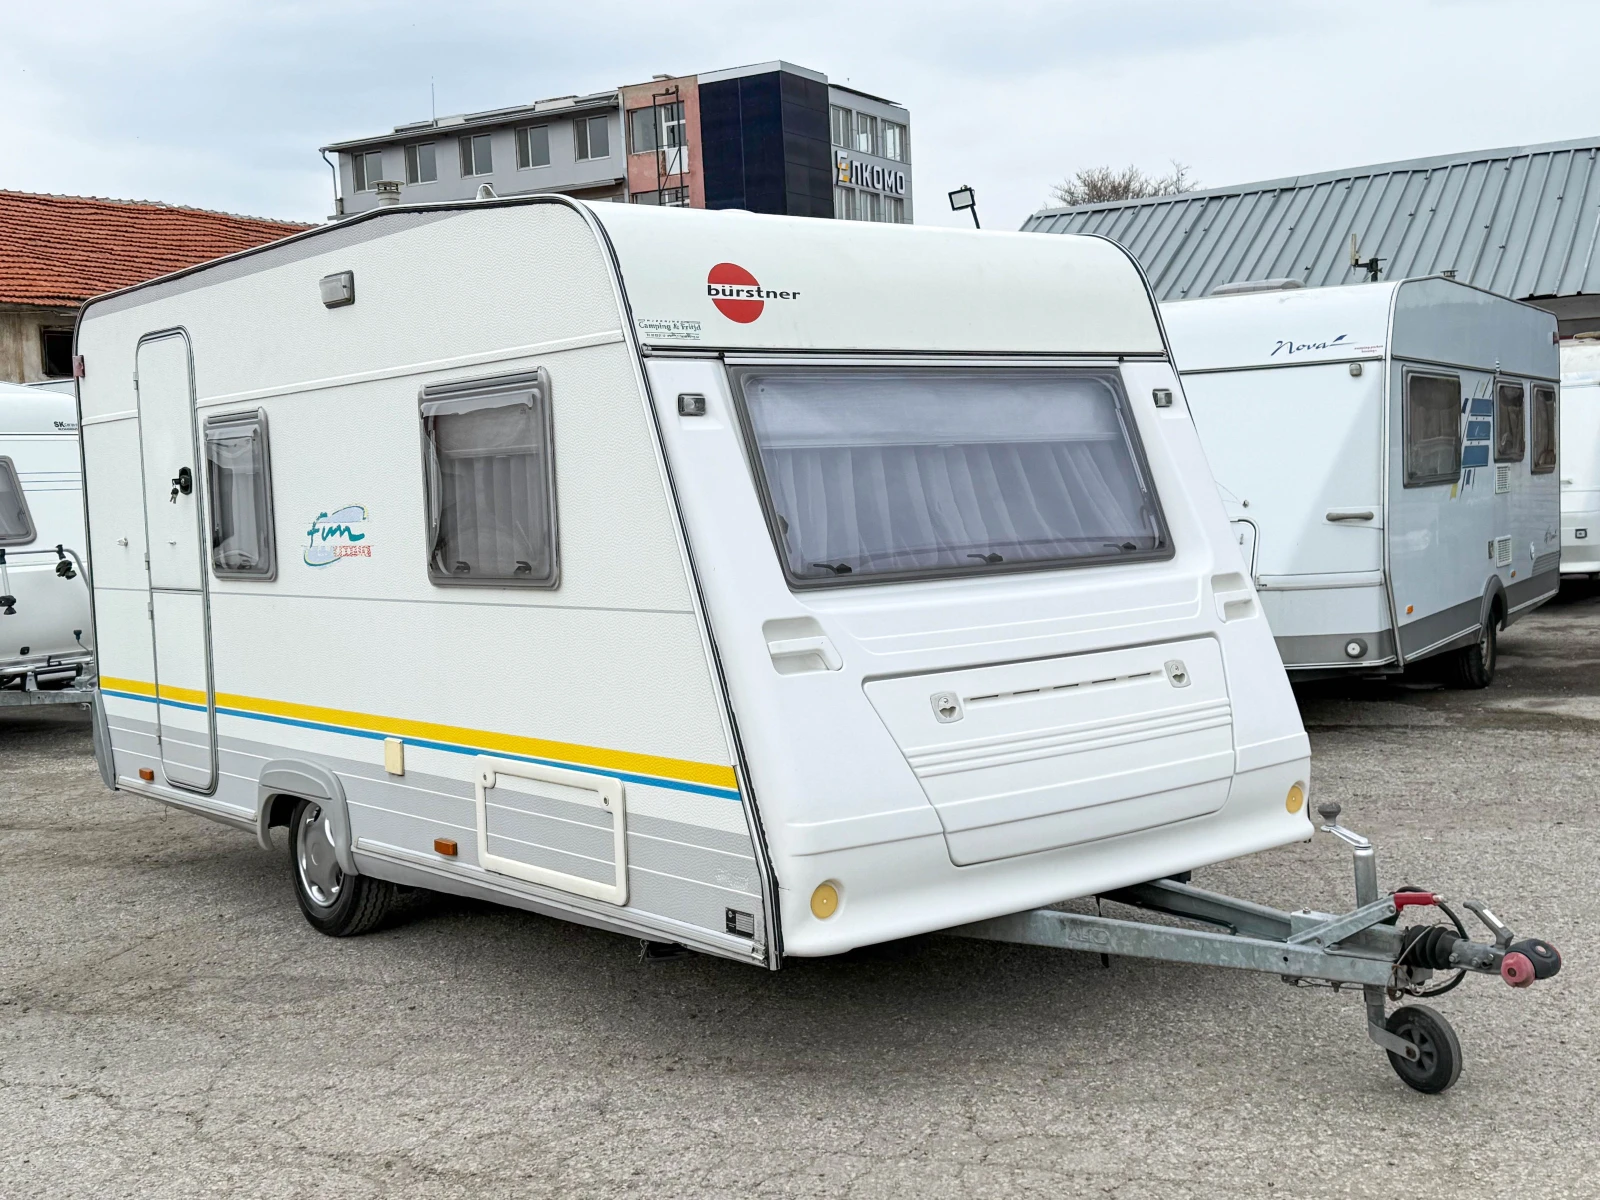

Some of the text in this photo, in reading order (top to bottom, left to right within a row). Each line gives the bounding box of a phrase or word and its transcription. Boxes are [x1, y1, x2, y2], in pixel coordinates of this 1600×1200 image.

[836, 150, 905, 194] ЕЛКОМО
[707, 284, 800, 300] bürstner
[638, 321, 672, 331] Camping
[1271, 339, 1338, 356] Nova
[307, 512, 365, 548] fun
